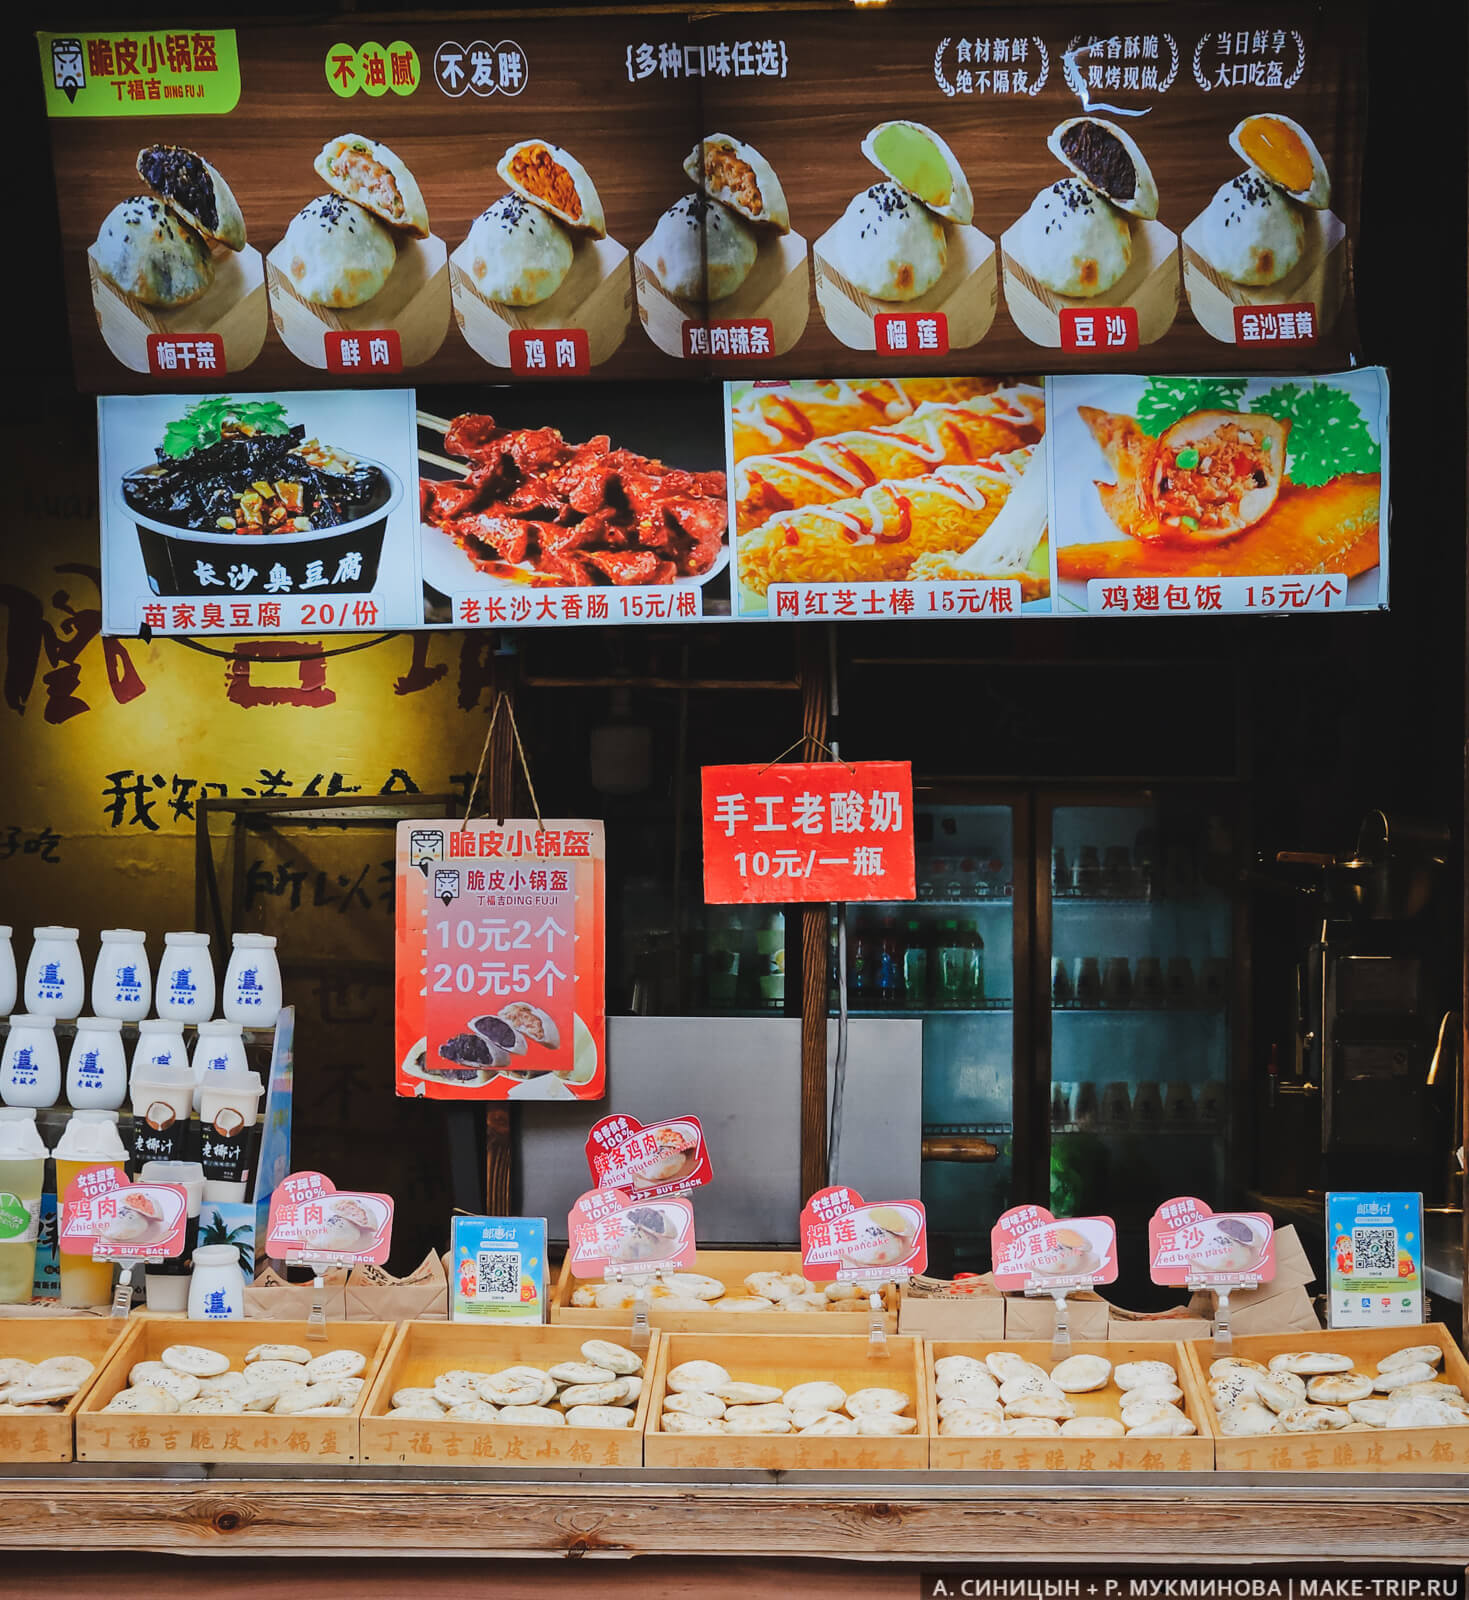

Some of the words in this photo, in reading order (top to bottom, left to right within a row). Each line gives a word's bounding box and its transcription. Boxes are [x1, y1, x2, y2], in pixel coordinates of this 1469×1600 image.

[87, 33, 218, 76] 脆皮小锅盔
[955, 37, 1029, 63] 食材新鲜
[1216, 30, 1287, 56] 当日鲜享
[332, 52, 415, 88] 不油腻
[441, 51, 523, 88] 不发胖
[955, 68, 1029, 95] 绝不隔夜
[1088, 65, 1159, 91] 现烤现做
[1214, 61, 1284, 89] 大口吃盔
[110, 78, 162, 101] 丁福吉
[164, 85, 183, 99] DING
[886, 320, 939, 350] 榴莲
[1075, 316, 1127, 347] 豆沙
[1241, 312, 1313, 341] 金沙蛋黄
[340, 339, 390, 367] 鲜肉
[524, 339, 576, 369] 鸡肉
[689, 327, 770, 356] 鸡肉辣条
[157, 341, 217, 371] 梅干菜
[193, 551, 363, 594] 长沙臭豆腐
[458, 594, 609, 622] 老长沙大香肠
[619, 591, 699, 620] 15元/根
[775, 588, 915, 616] 网红芝士棒
[927, 586, 1014, 614] 15元/根
[1101, 584, 1223, 612] 鸡翅包饭
[1244, 578, 1342, 609] 15元/个
[142, 602, 282, 629] 苗家臭豆腐
[300, 599, 379, 627] 20/份
[713, 789, 903, 837] 手工老酸奶
[449, 830, 591, 858] 脆皮小锅盔
[733, 845, 886, 879] 10元/一瓶
[466, 870, 568, 891] 脆皮小锅盔
[436, 916, 567, 953] 10元2个
[432, 959, 567, 997] 20元5个
[135, 1135, 174, 1155] 老椰汁
[202, 1141, 241, 1160] 老椰汁
[602, 1128, 634, 1150] 100%
[601, 1171, 626, 1188] Spicy
[627, 1154, 659, 1175] Gluten
[83, 1180, 120, 1197] 100%
[290, 1187, 326, 1202] 100%
[656, 1185, 673, 1195] BUY
[68, 1196, 117, 1221] 鸡肉
[275, 1203, 323, 1226] 鲜肉
[586, 1202, 622, 1220] 100%
[818, 1201, 855, 1221] 100%
[1167, 1211, 1204, 1229] 100%
[70, 1221, 110, 1232] chicken
[305, 1227, 328, 1237] pork
[574, 1217, 626, 1247] 梅菜
[807, 1219, 857, 1248] 榴莲
[1009, 1218, 1045, 1236] 100%
[1157, 1226, 1204, 1253] 豆沙
[812, 1248, 845, 1261] durian
[847, 1237, 889, 1254] pancake
[996, 1230, 1058, 1263] 金沙蛋黄
[1178, 1250, 1203, 1261] bean
[1205, 1246, 1233, 1259] paste
[1002, 1259, 1035, 1273] Salted
[1038, 1255, 1058, 1266] Egg
